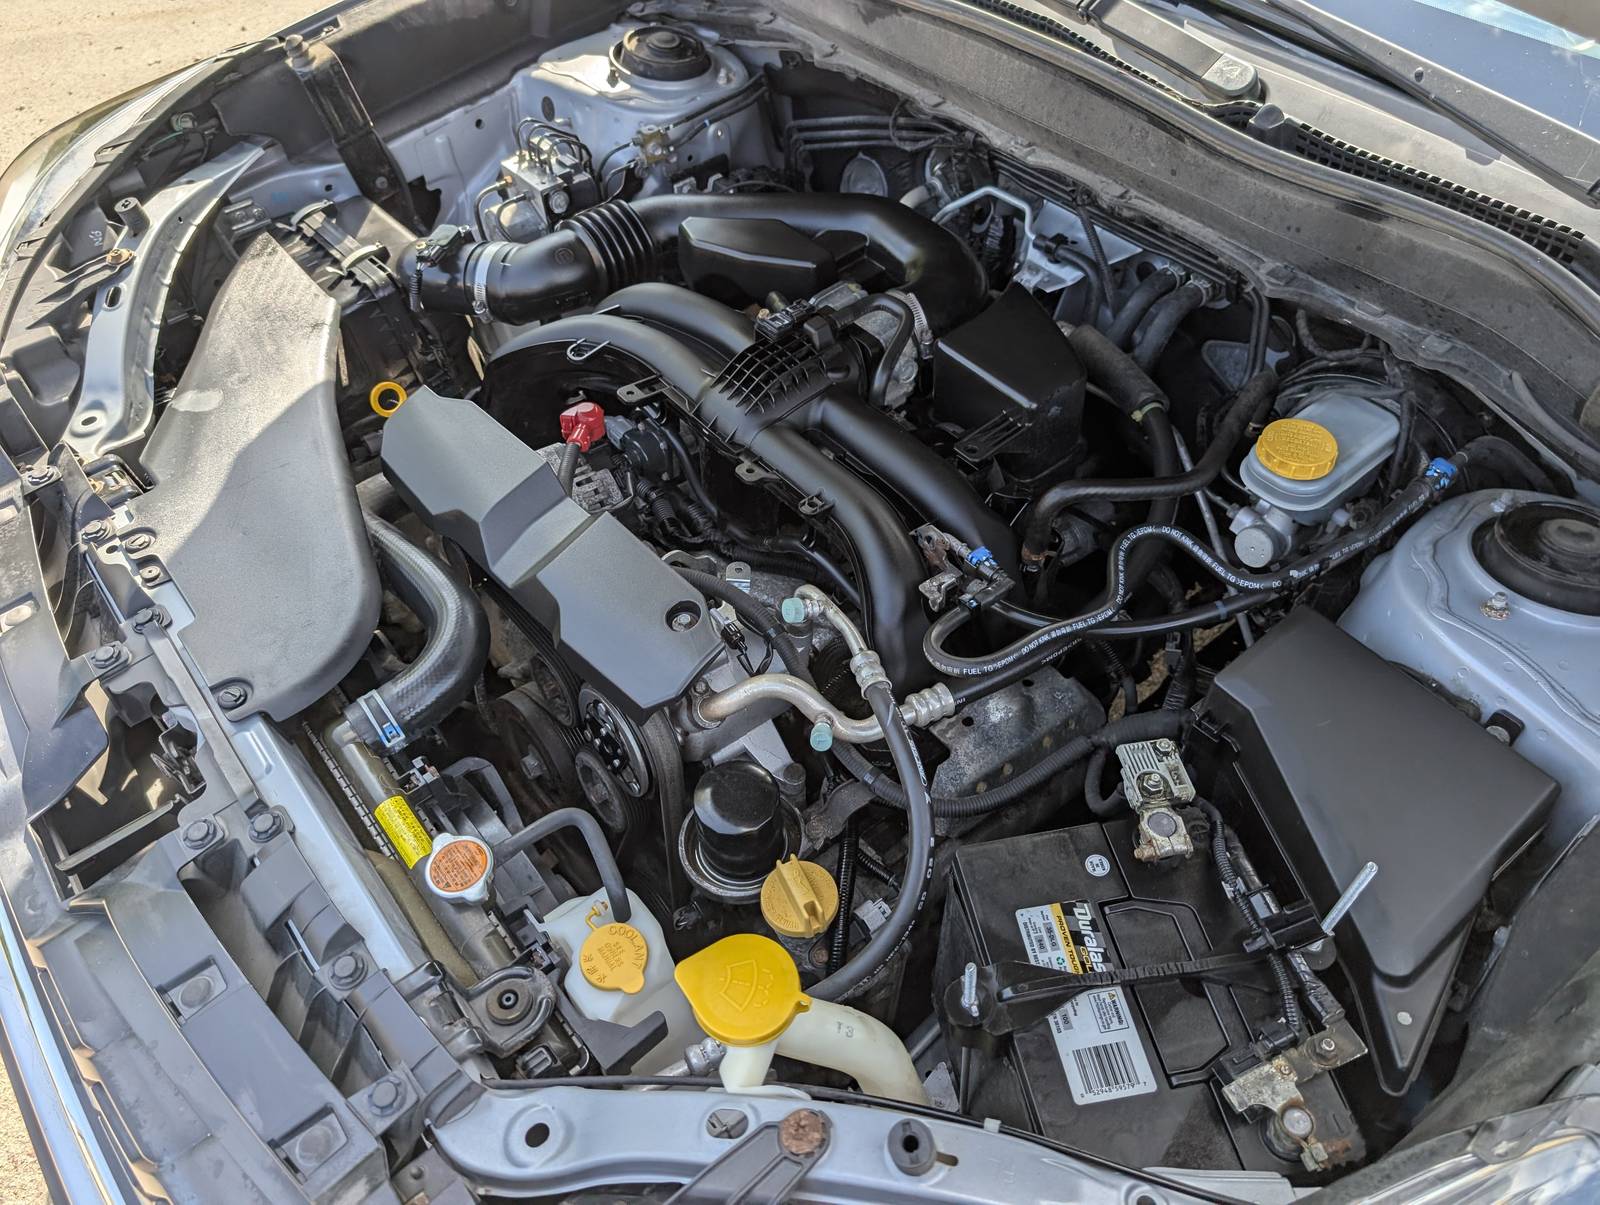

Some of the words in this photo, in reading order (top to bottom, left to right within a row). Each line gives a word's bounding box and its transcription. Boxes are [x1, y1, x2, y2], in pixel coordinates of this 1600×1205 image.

[1170, 529, 1182, 540] NOT
[1120, 539, 1131, 551] FUEL
[1211, 563, 1226, 577] FUEL
[1226, 573, 1236, 583] TG
[1272, 580, 1282, 588] DO
[1116, 594, 1124, 605] DO
[1072, 620, 1087, 630] FUEL
[1087, 617, 1096, 625] TG
[1021, 646, 1030, 655] DO
[1028, 639, 1039, 650] NOT
[963, 667, 982, 675] FUEL
[983, 664, 993, 673] TG
[1056, 915, 1071, 948] PROVEN
[1073, 903, 1107, 972] Duralas
[608, 925, 645, 969] COOLANT
[1080, 946, 1093, 974] GOL
